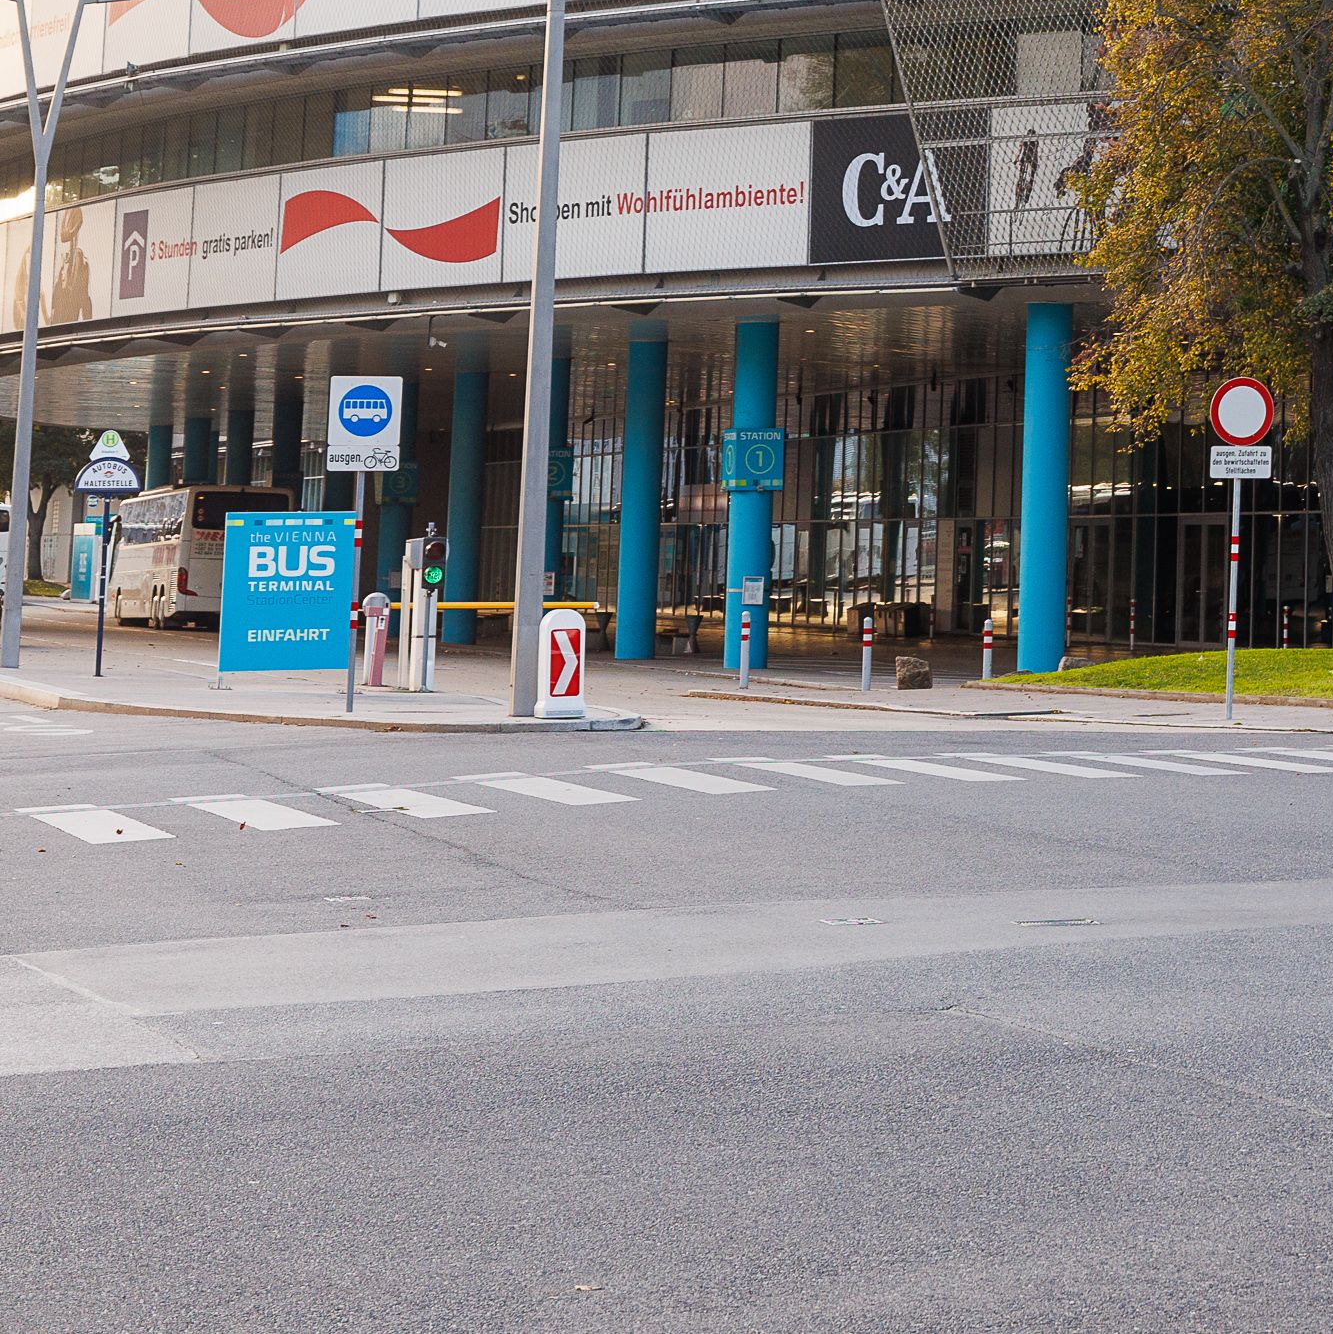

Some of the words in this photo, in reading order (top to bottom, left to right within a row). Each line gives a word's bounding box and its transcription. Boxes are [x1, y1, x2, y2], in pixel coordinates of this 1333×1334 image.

[842, 150, 952, 227] C&A
[585, 195, 612, 218] mit
[617, 181, 804, 215] Wohlfühlambiente!
[150, 240, 156, 261] 3
[158, 237, 198, 260] Stunden
[202, 232, 231, 260] gratis
[234, 227, 274, 257] parken!
[106, 434, 115, 445] H
[739, 431, 782, 441] STATION
[329, 453, 364, 465] ausgen.
[1238, 449, 1259, 457] Zufahrt
[92, 462, 128, 474] AUTOBUS
[83, 479, 133, 487] HALTESTELLE
[250, 532, 271, 543] the
[274, 531, 337, 542] VIENNA
[248, 545, 337, 578] BUS
[248, 580, 335, 592] TERMINAL
[247, 594, 333, 606] StadionCenter
[247, 628, 331, 642] EINFAHRT
